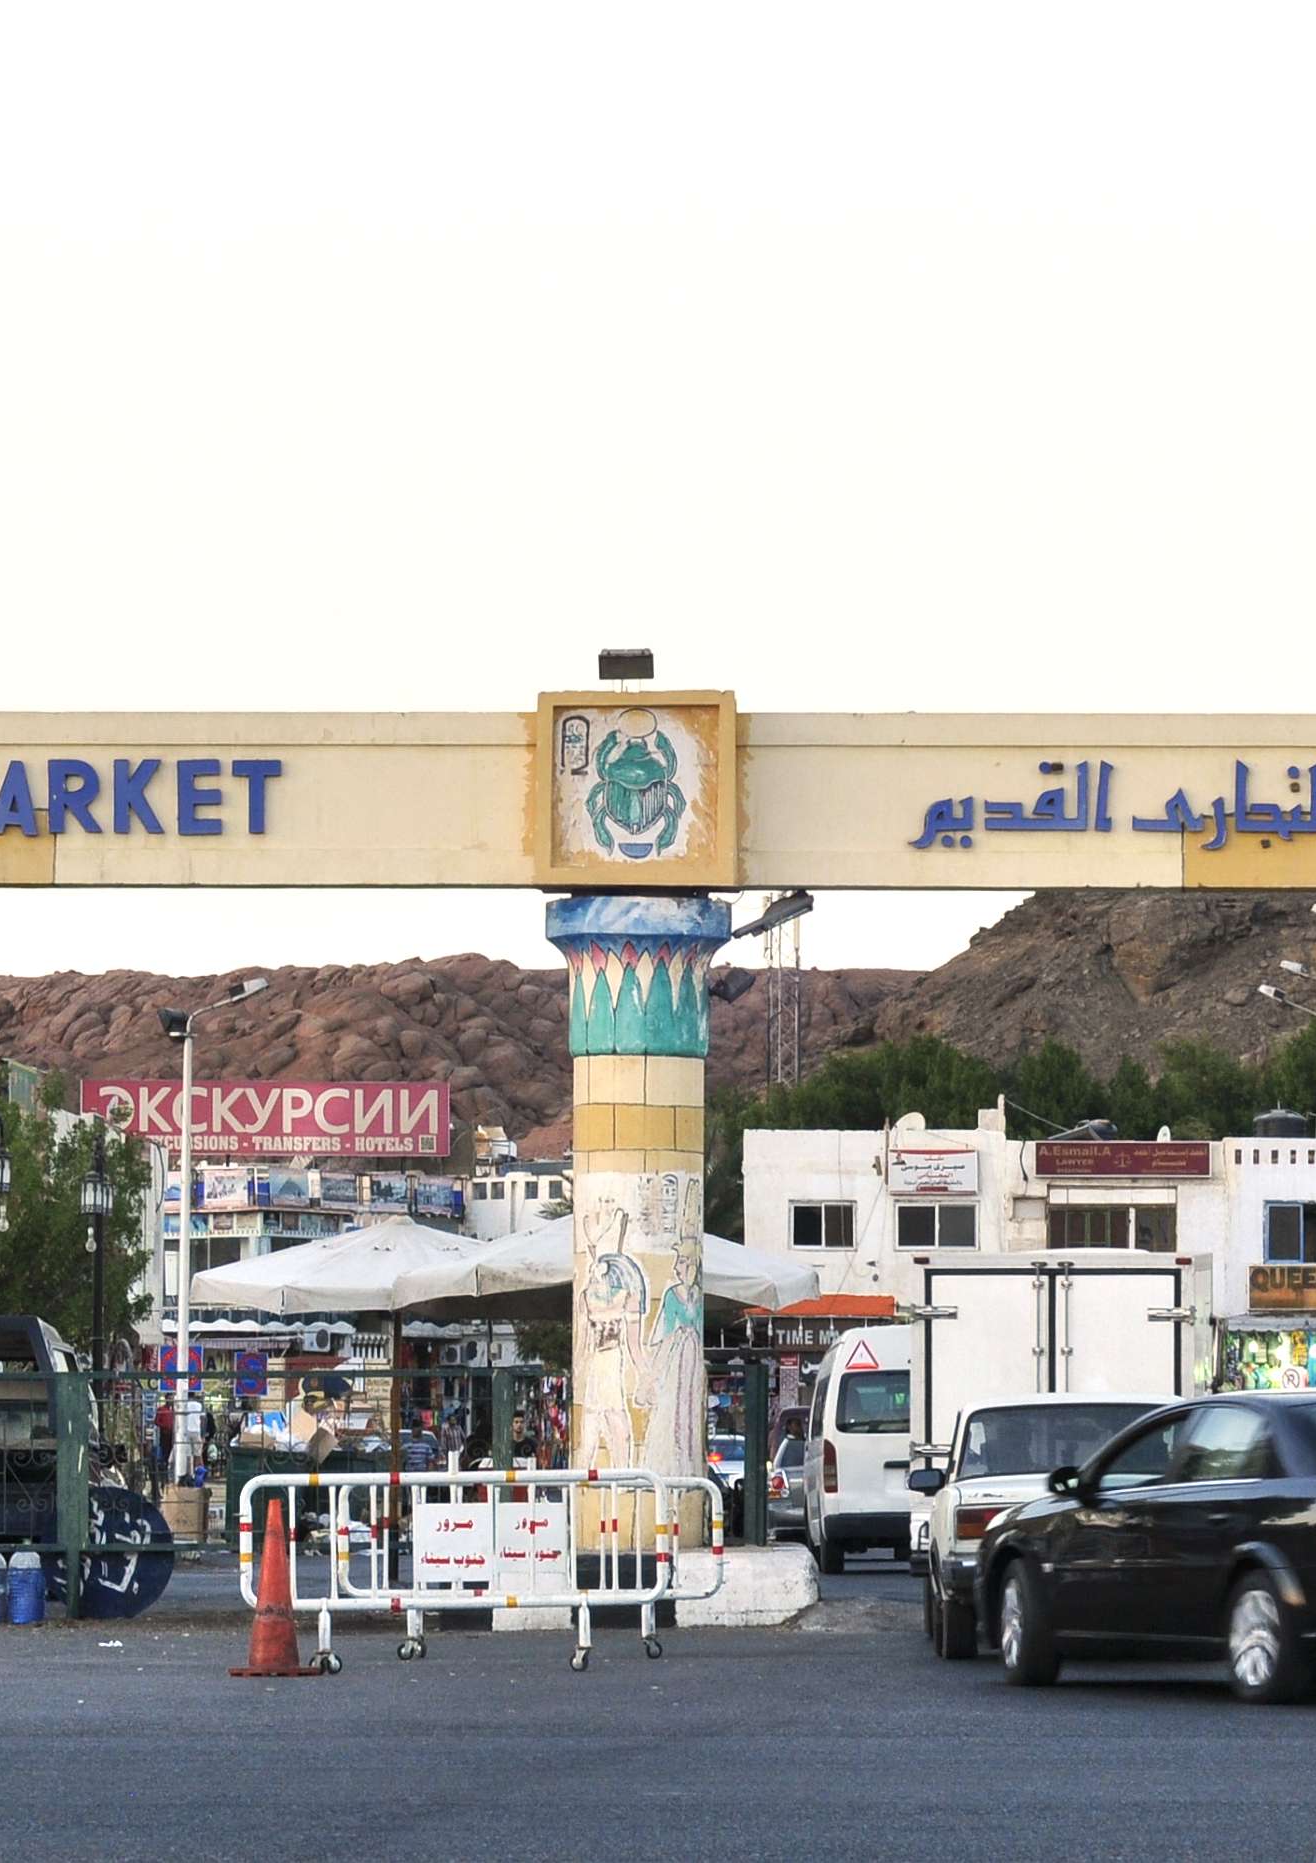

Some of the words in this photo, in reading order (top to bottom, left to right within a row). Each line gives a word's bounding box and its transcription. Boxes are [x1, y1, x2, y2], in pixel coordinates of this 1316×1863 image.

[907, 759, 1114, 850] القديم
[98, 1085, 439, 1134] ЭКСКУРСИИ
[149, 1134, 239, 1153] XCUSIONS
[252, 1134, 341, 1153] TRANSFERS
[354, 1135, 414, 1153] HOTELS
[1055, 1158, 1094, 1166] LAWYER
[776, 1329, 814, 1345] TIME
[436, 1517, 474, 1532] مرور
[421, 1551, 451, 1567] سيناء
[453, 1552, 486, 1568] جنوب
[530, 1549, 563, 1562] جنو
